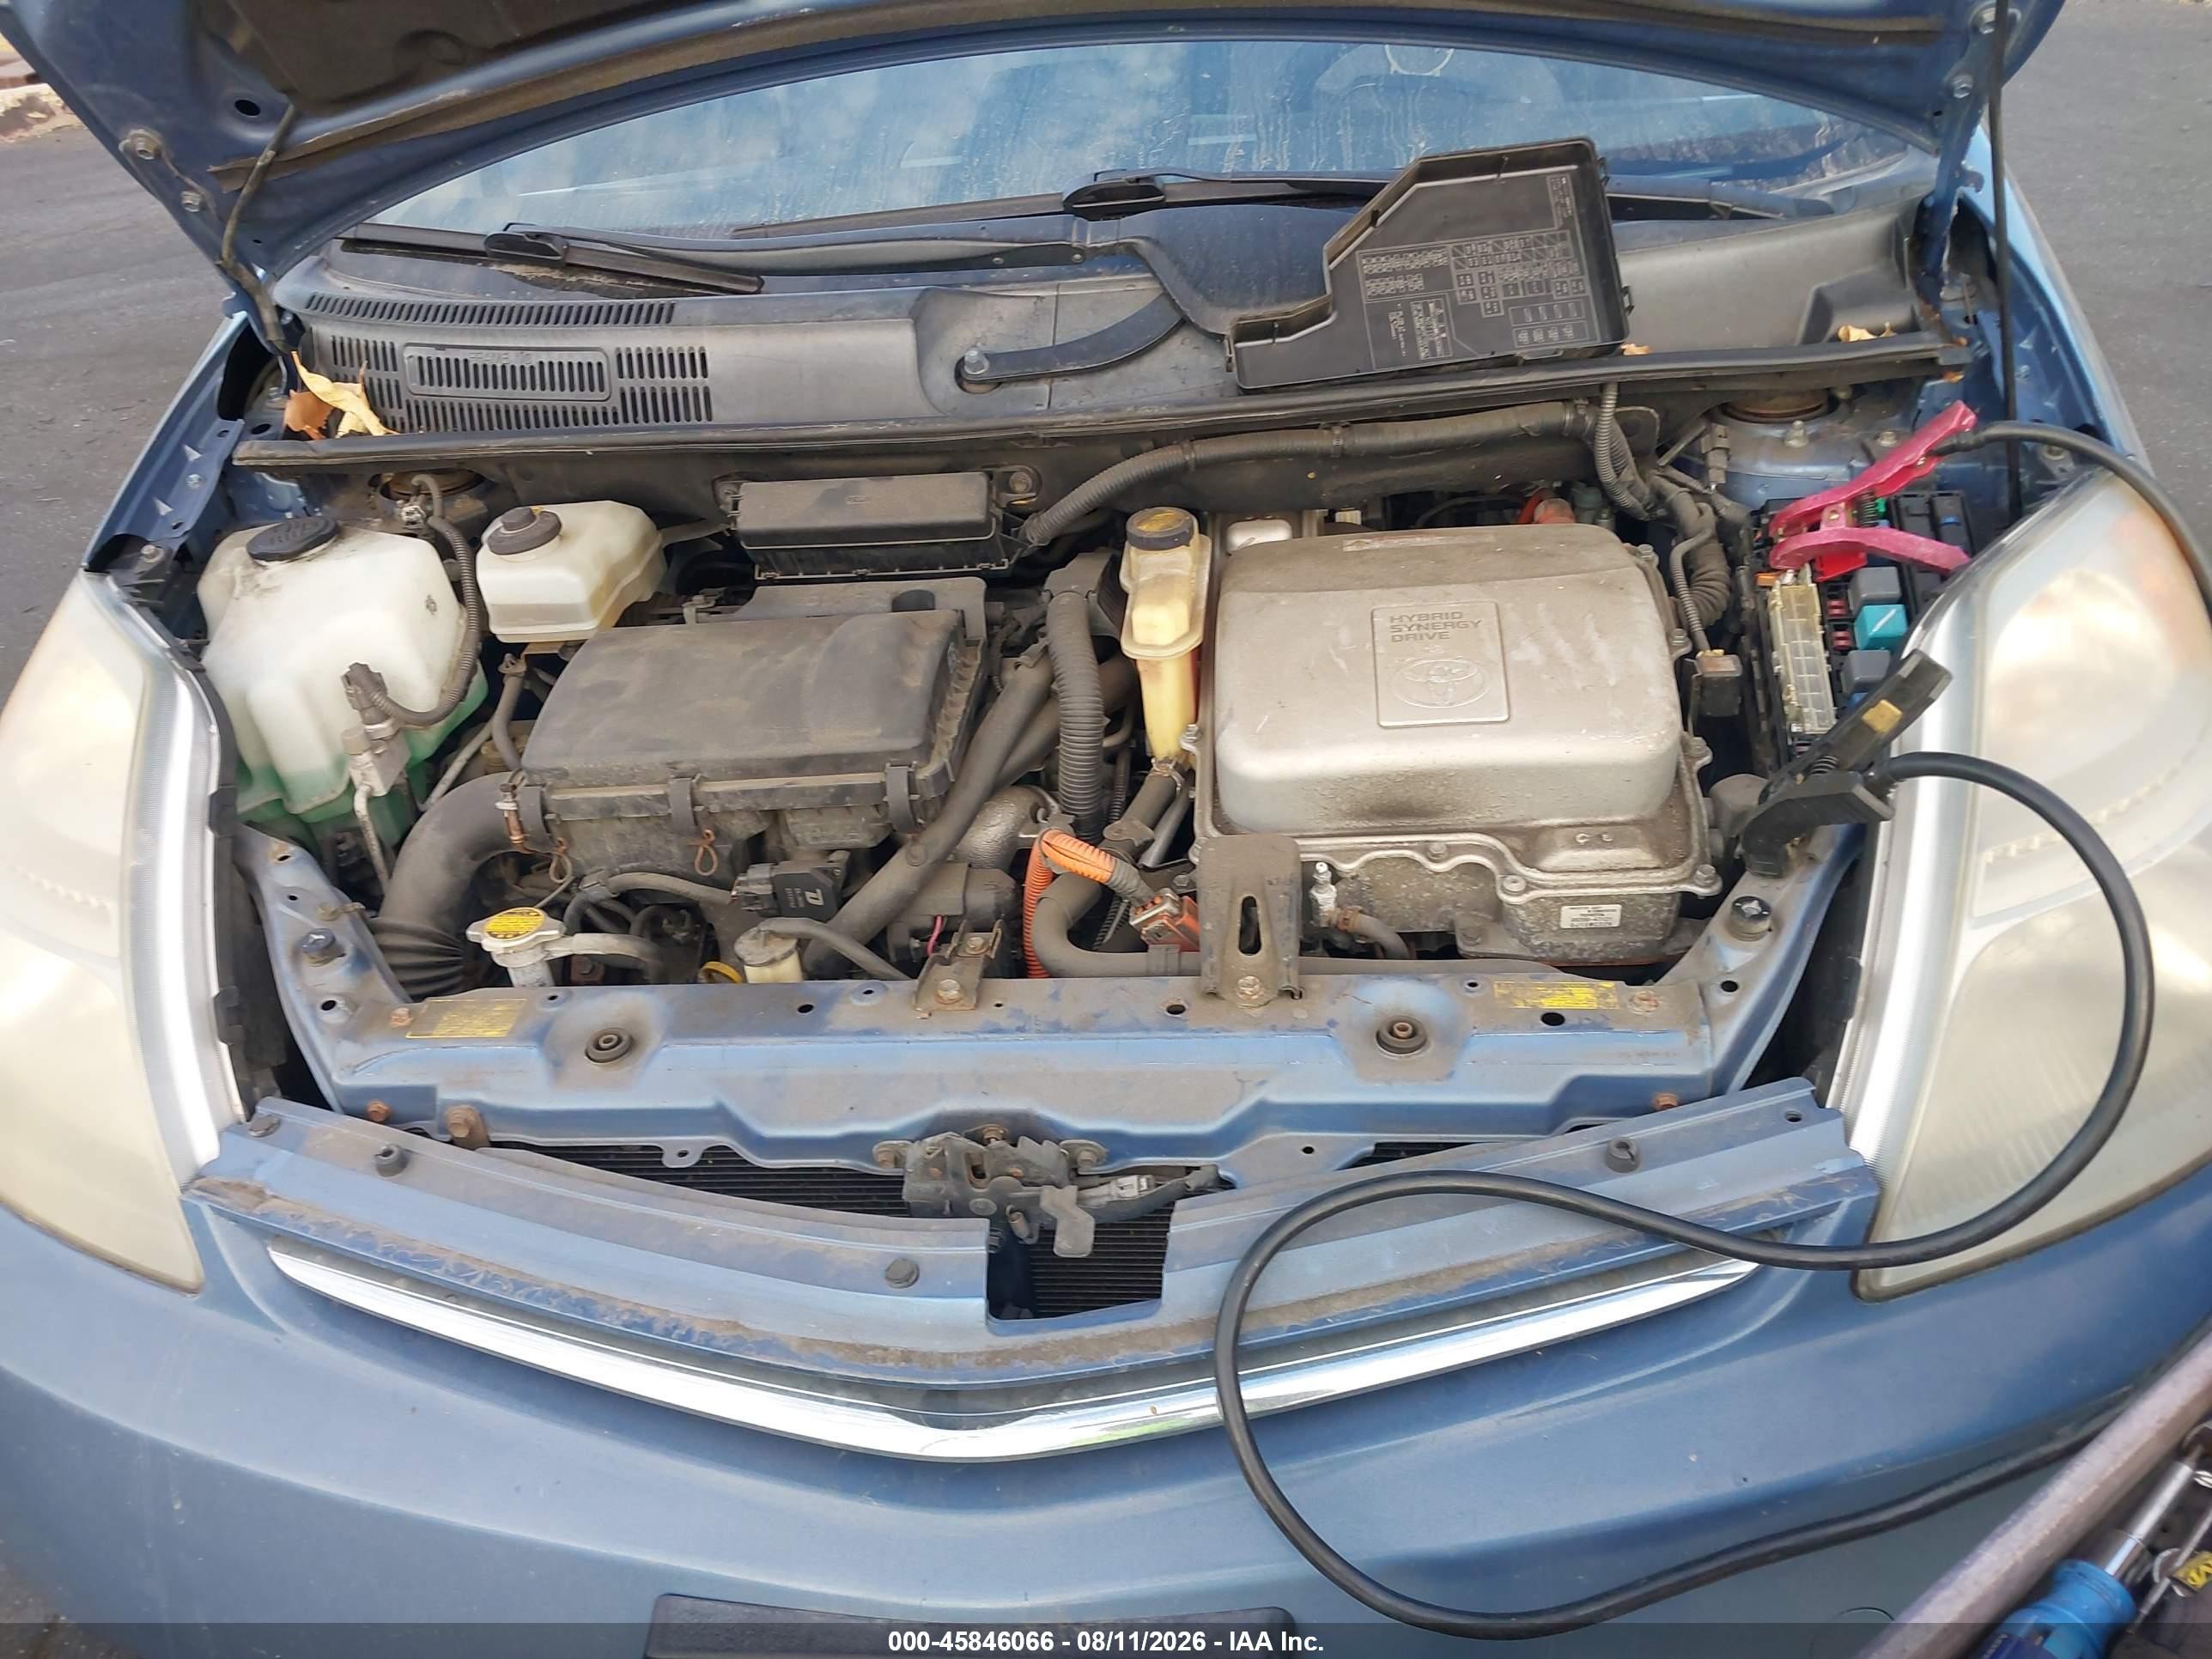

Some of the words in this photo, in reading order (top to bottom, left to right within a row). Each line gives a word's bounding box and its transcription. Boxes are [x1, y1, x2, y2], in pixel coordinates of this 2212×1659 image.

[1389, 611, 1463, 623] HYBRID
[1389, 619, 1482, 633] SYNERGY
[1391, 631, 1450, 643] DRIVE
